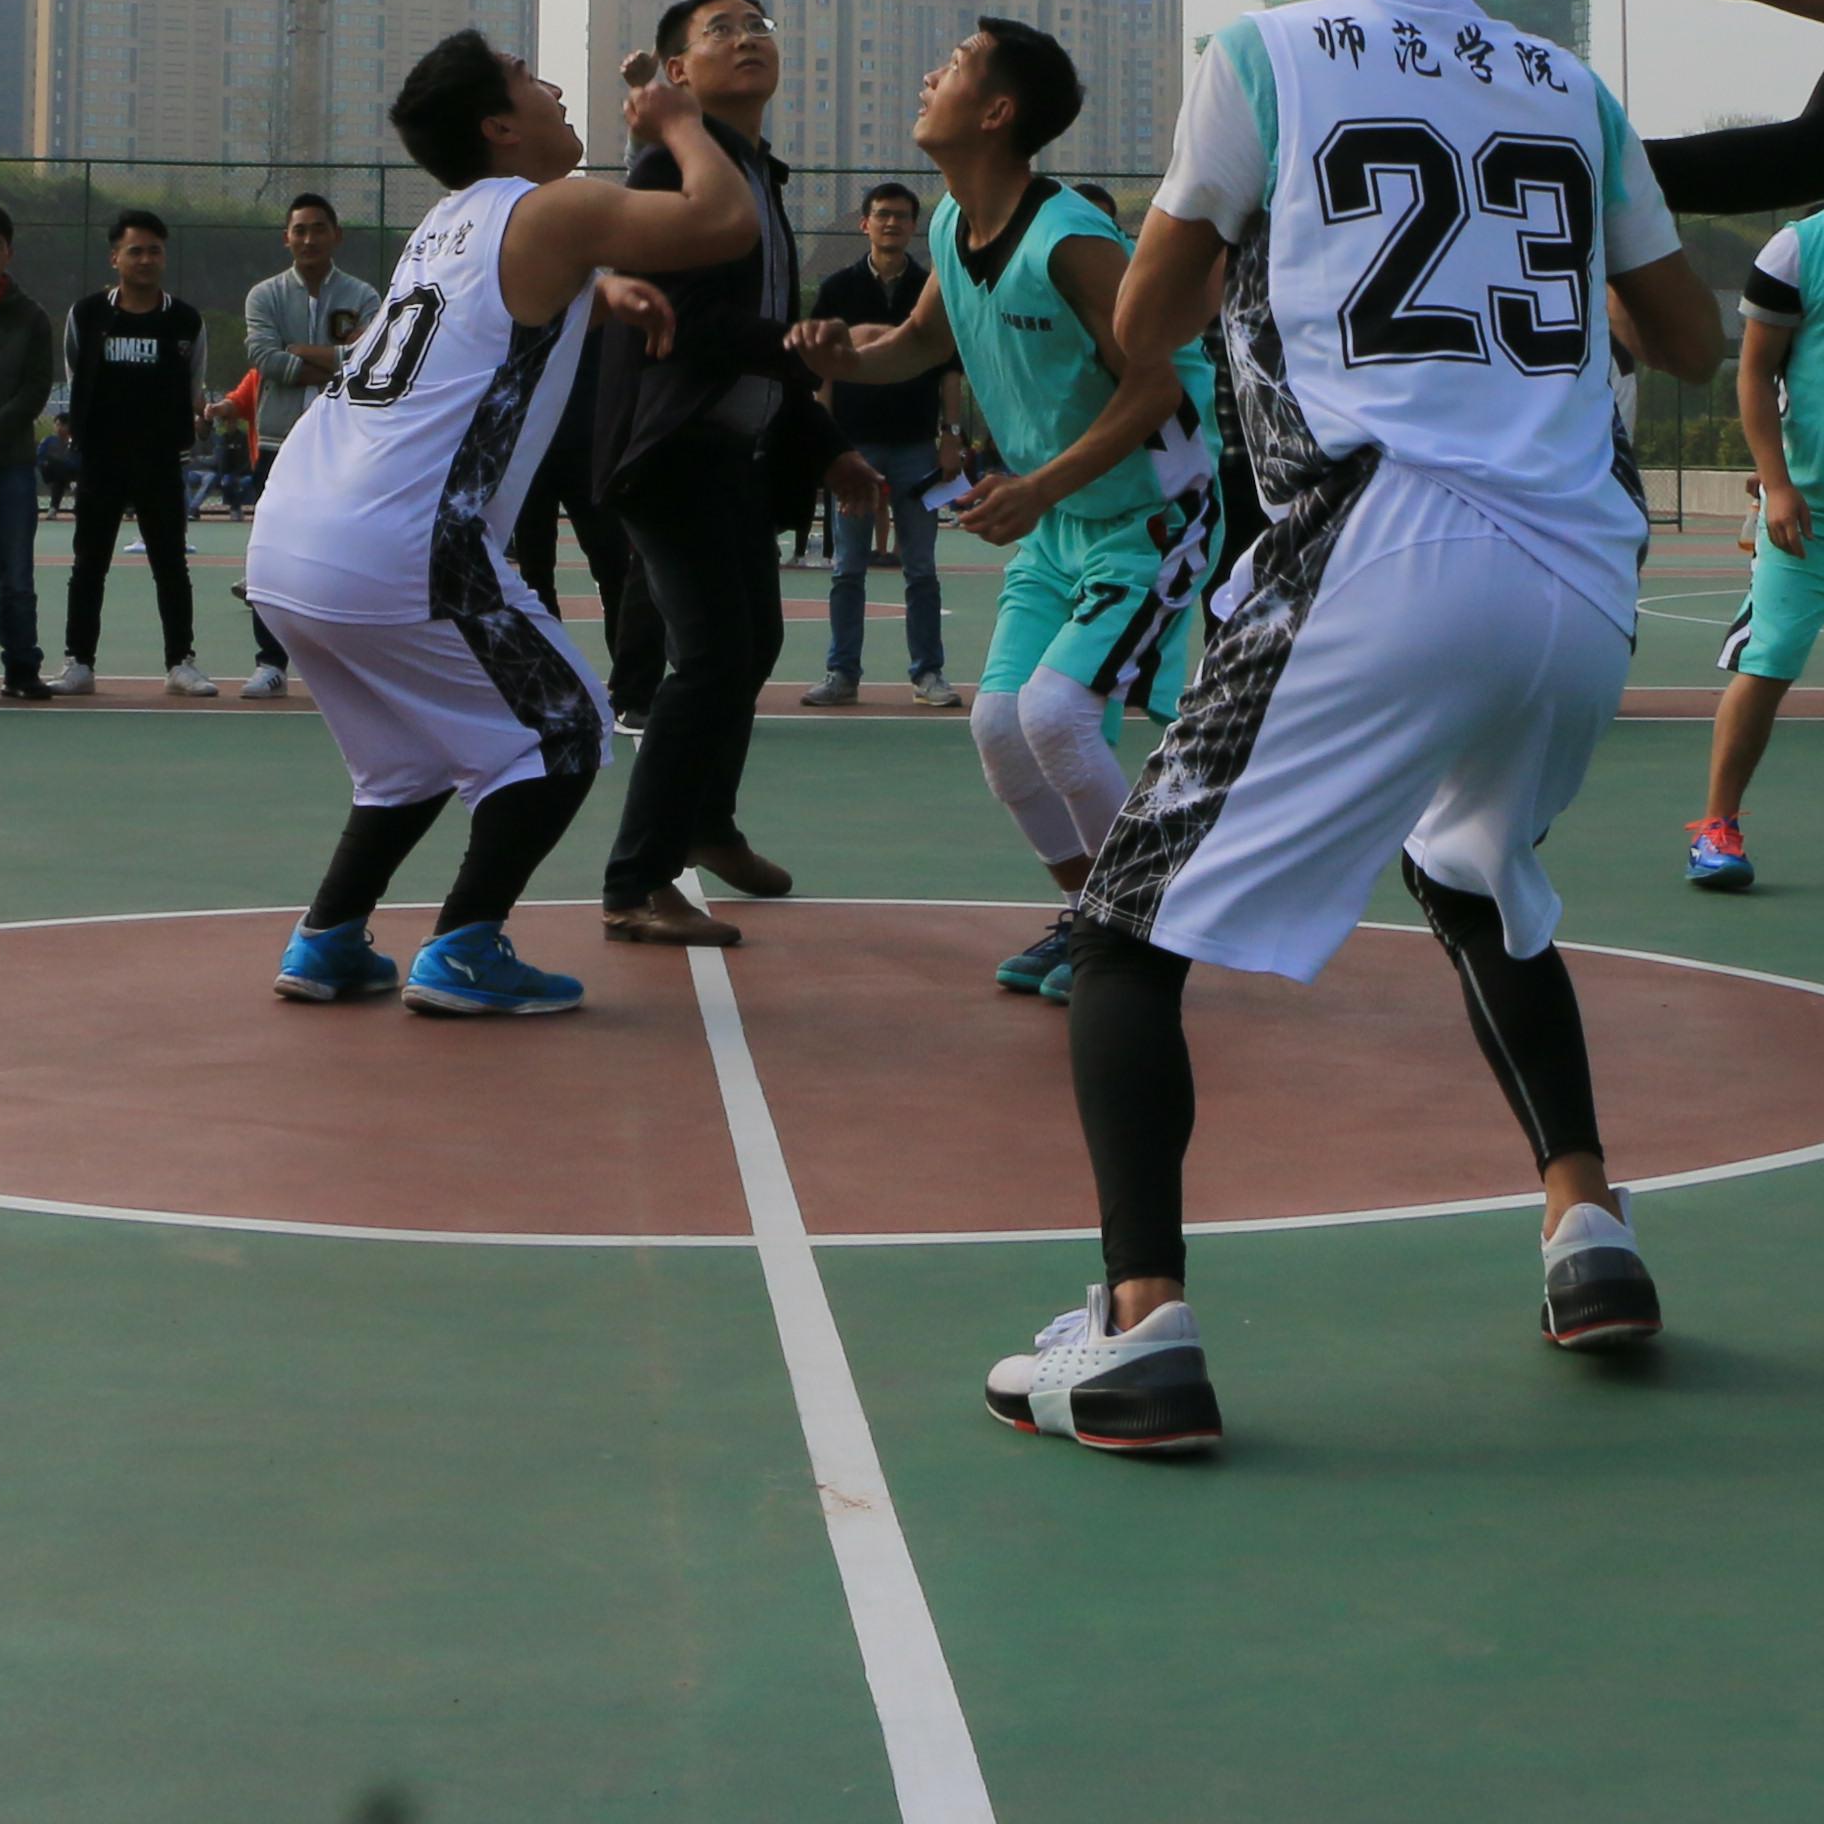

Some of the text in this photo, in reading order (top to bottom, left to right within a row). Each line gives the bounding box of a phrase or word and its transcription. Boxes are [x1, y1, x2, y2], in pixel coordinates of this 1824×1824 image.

[1314, 16, 1569, 93] 师范学院
[1313, 117, 1597, 377] 23
